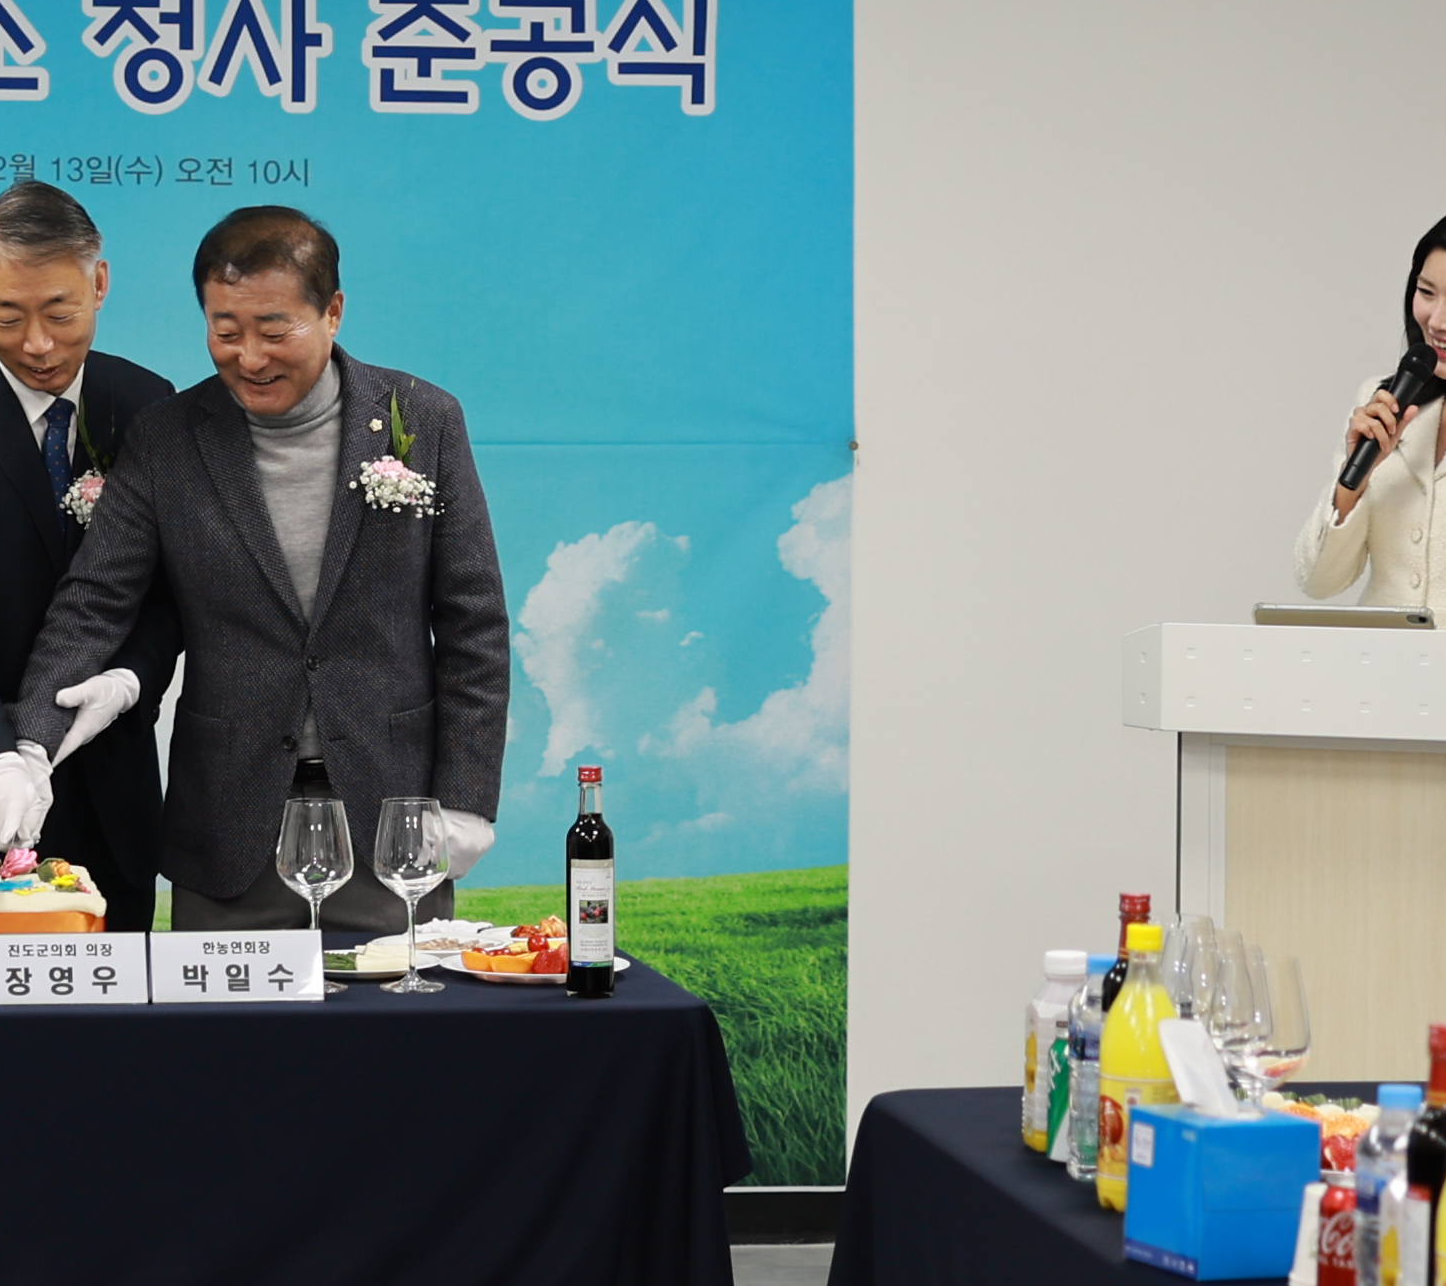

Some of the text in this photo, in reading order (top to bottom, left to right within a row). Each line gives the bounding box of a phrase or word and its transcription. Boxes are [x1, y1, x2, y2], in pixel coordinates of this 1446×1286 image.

[51, 154, 164, 187] 13일(수)
[174, 156, 234, 187] 오전
[248, 157, 310, 188] 10시
[8, 943, 113, 958] 진도군의회 의장
[202, 940, 271, 955] 한농연회장
